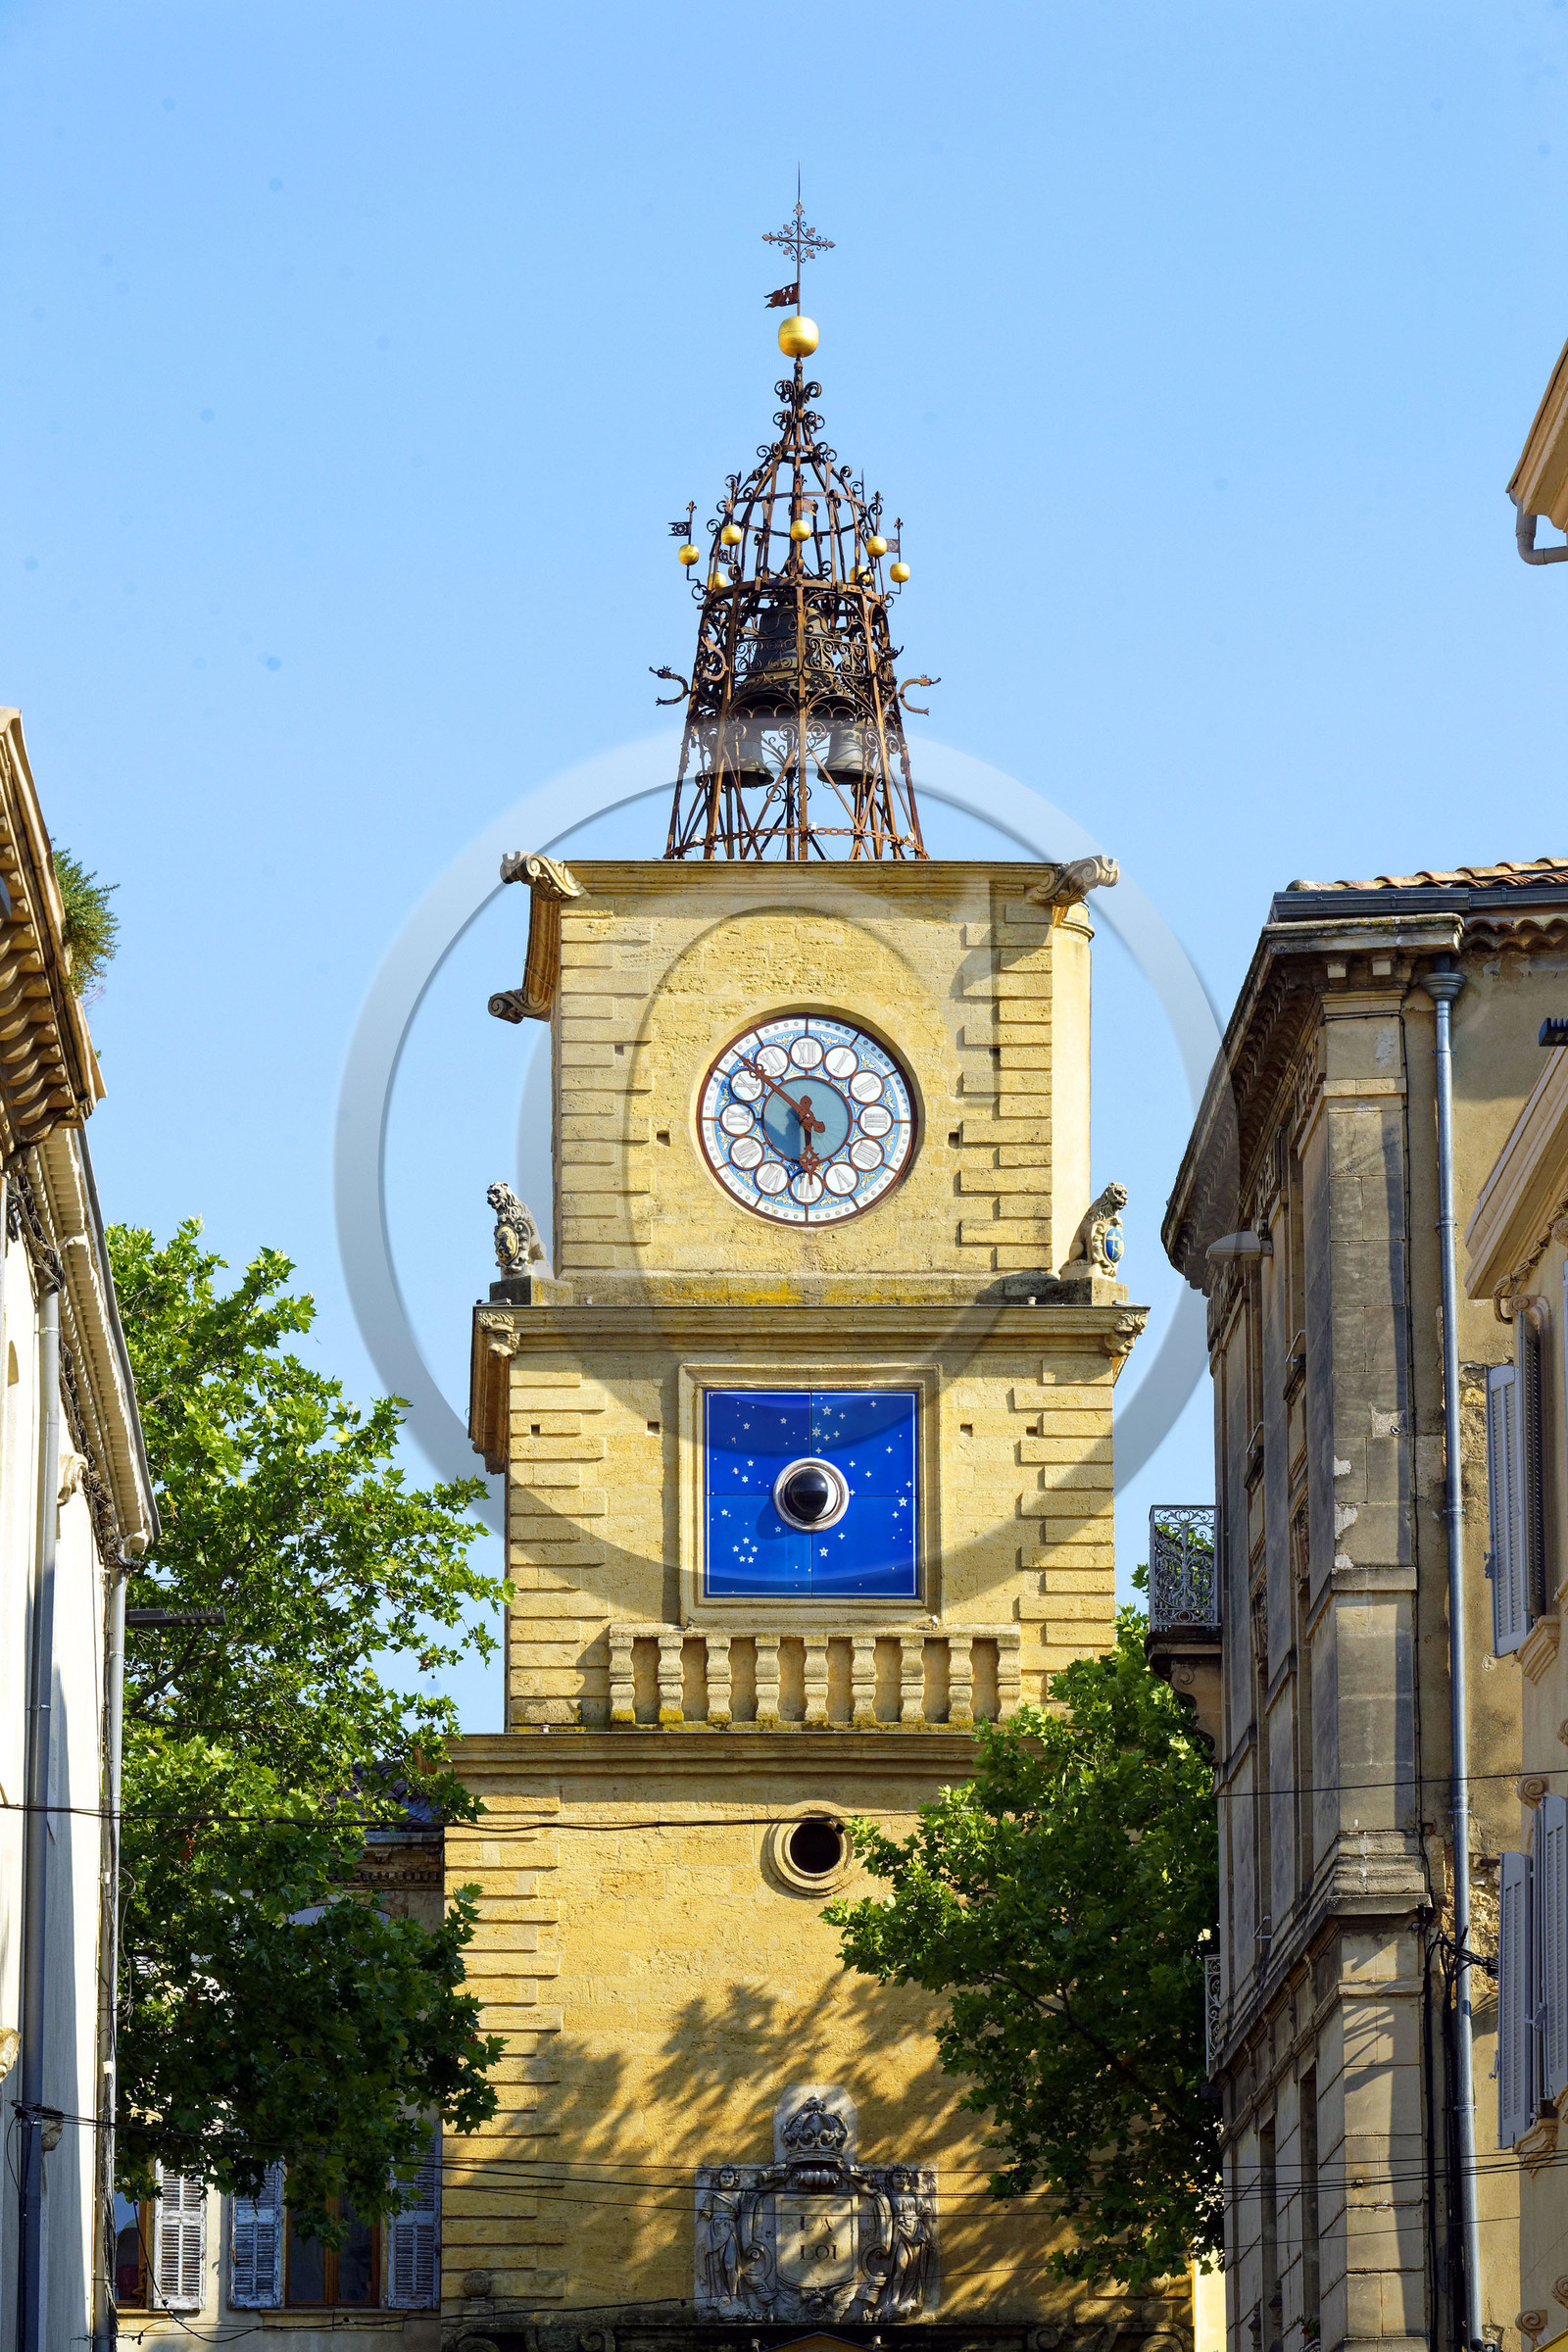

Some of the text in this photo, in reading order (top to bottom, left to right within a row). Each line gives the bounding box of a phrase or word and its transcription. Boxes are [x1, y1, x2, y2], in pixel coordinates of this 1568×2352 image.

[760, 1048, 785, 1076] XI
[797, 1042, 816, 1064] XII
[833, 1051, 850, 1073] I
[733, 1074, 760, 1096] X
[854, 1077, 879, 1097] II
[726, 1108, 750, 1127] IX
[864, 1112, 888, 1129] III
[732, 1139, 760, 1167] VIII
[853, 1141, 882, 1167] IIII
[759, 1163, 784, 1191] VII
[834, 1167, 854, 1191] V
[800, 2216, 833, 2232] LA
[800, 2244, 837, 2261] LOI
